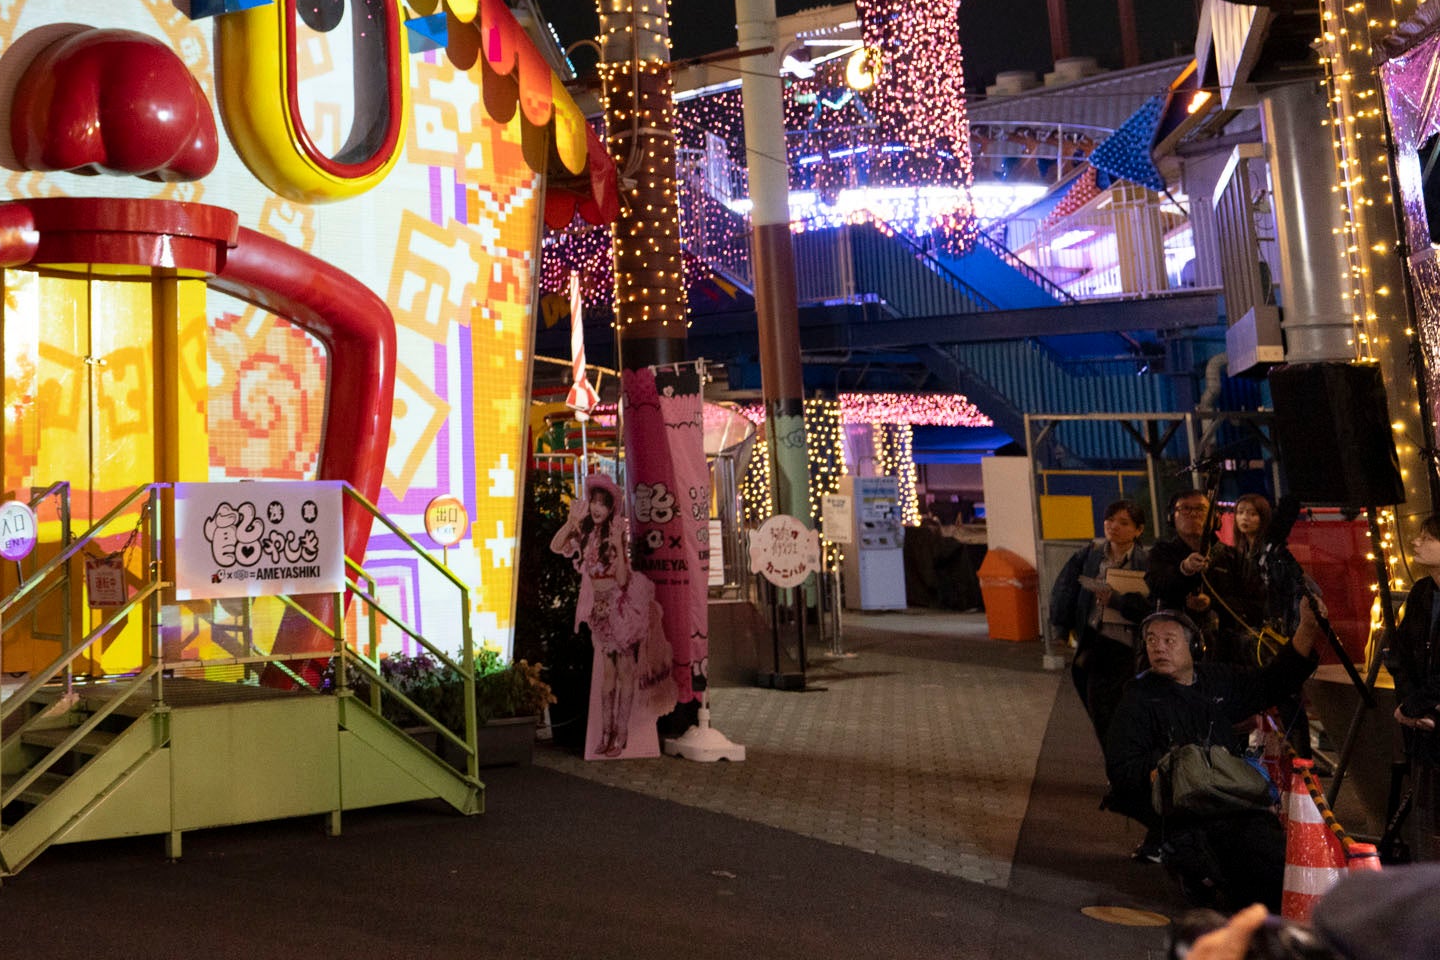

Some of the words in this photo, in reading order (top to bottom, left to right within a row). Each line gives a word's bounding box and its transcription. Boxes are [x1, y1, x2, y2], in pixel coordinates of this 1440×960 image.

[436, 507, 458, 523] 出口
[2, 514, 25, 536] 入口
[256, 566, 320, 580] AMEYASHIKI
